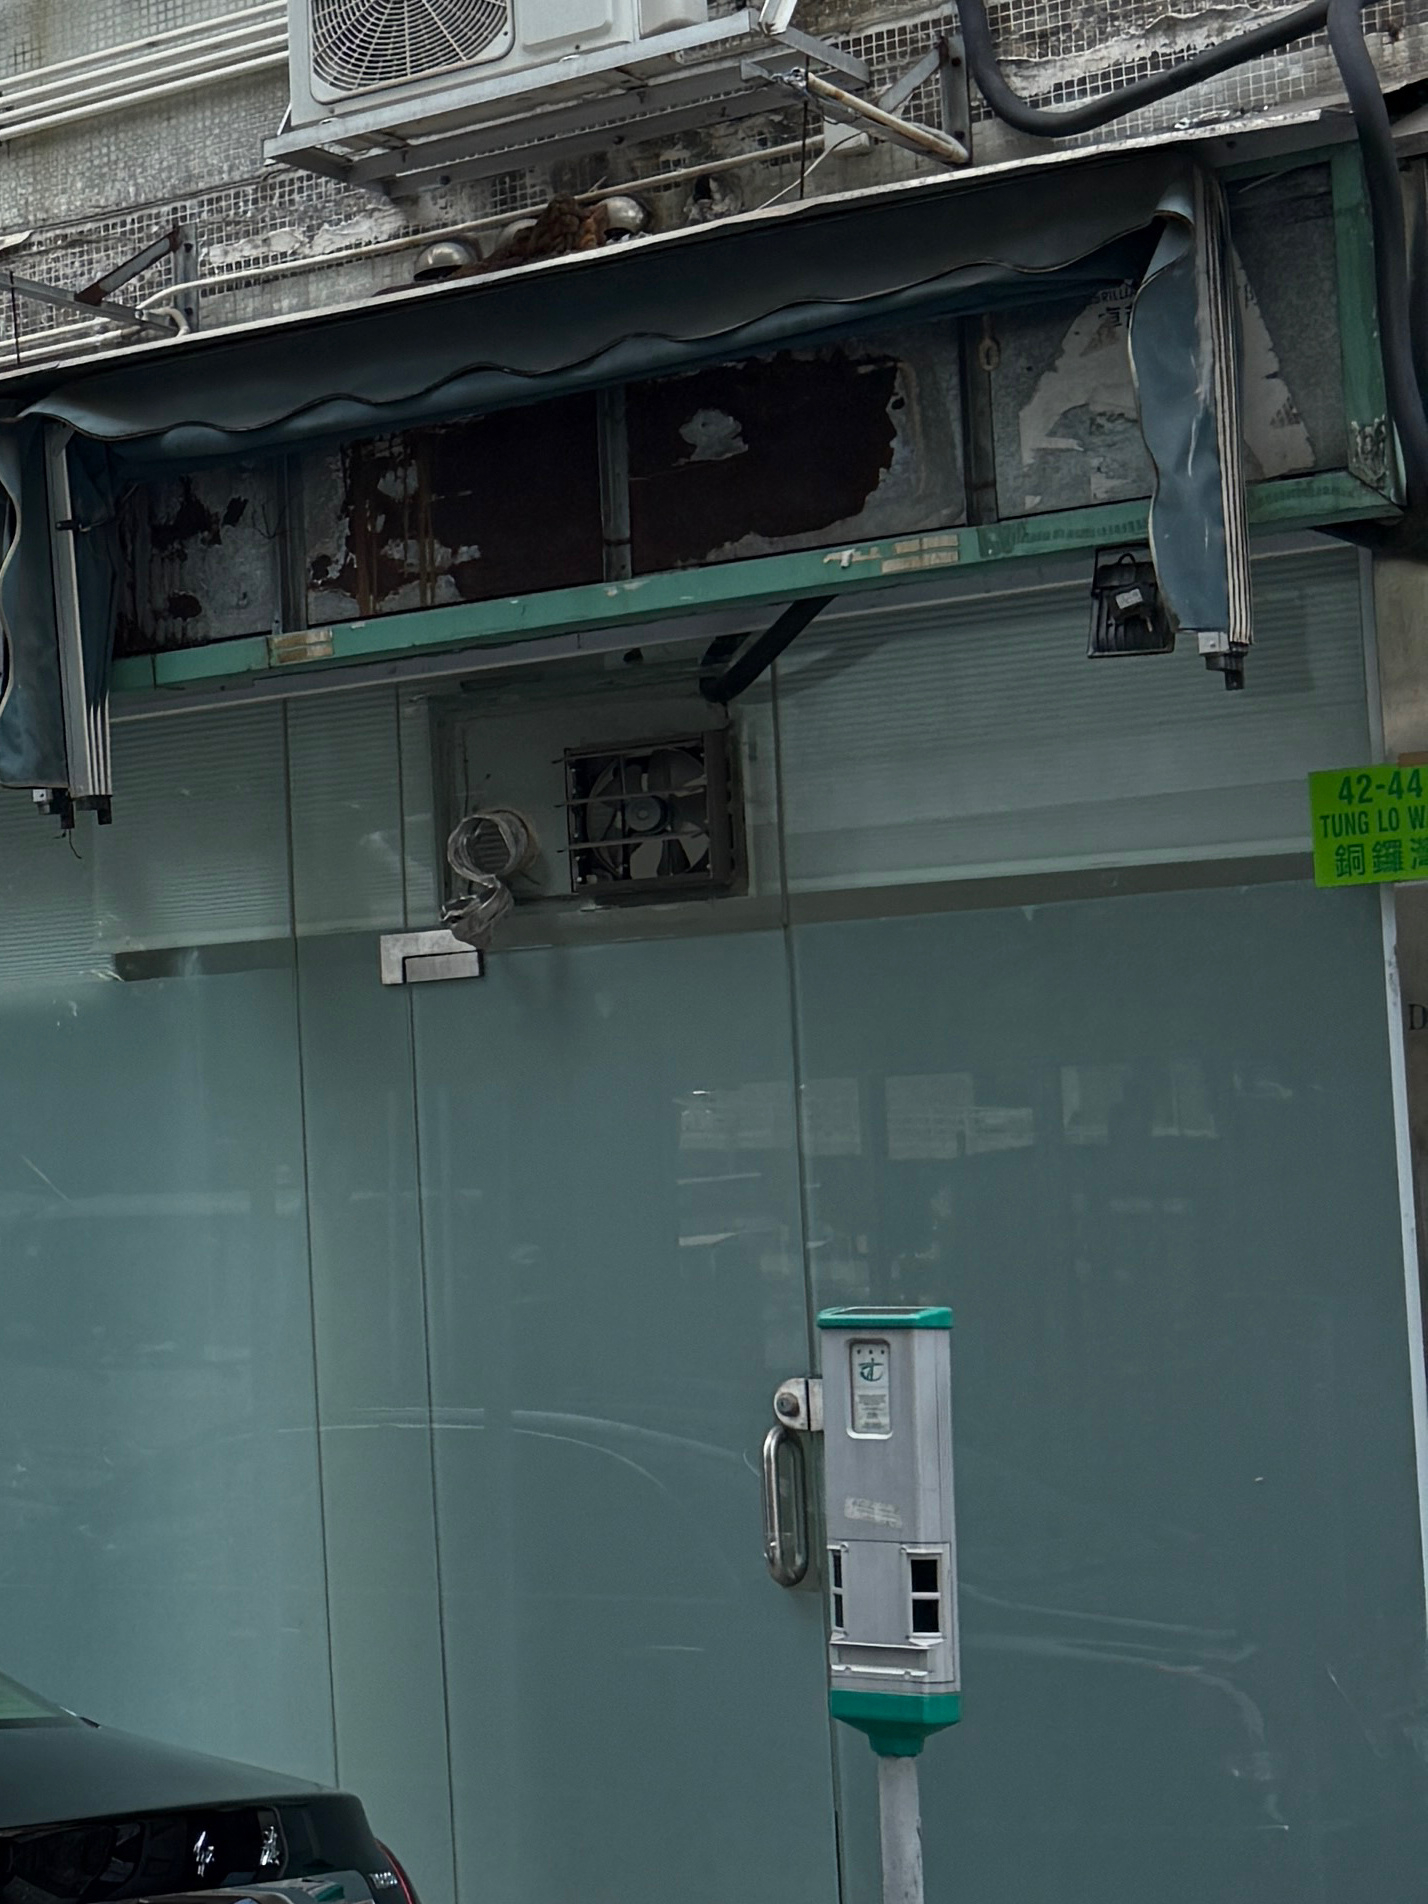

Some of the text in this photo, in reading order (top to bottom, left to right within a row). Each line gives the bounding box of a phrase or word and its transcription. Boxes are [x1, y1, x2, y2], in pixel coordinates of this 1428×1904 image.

[1338, 768, 1423, 805] 42-44
[1319, 804, 1428, 838] TUNG LO W
